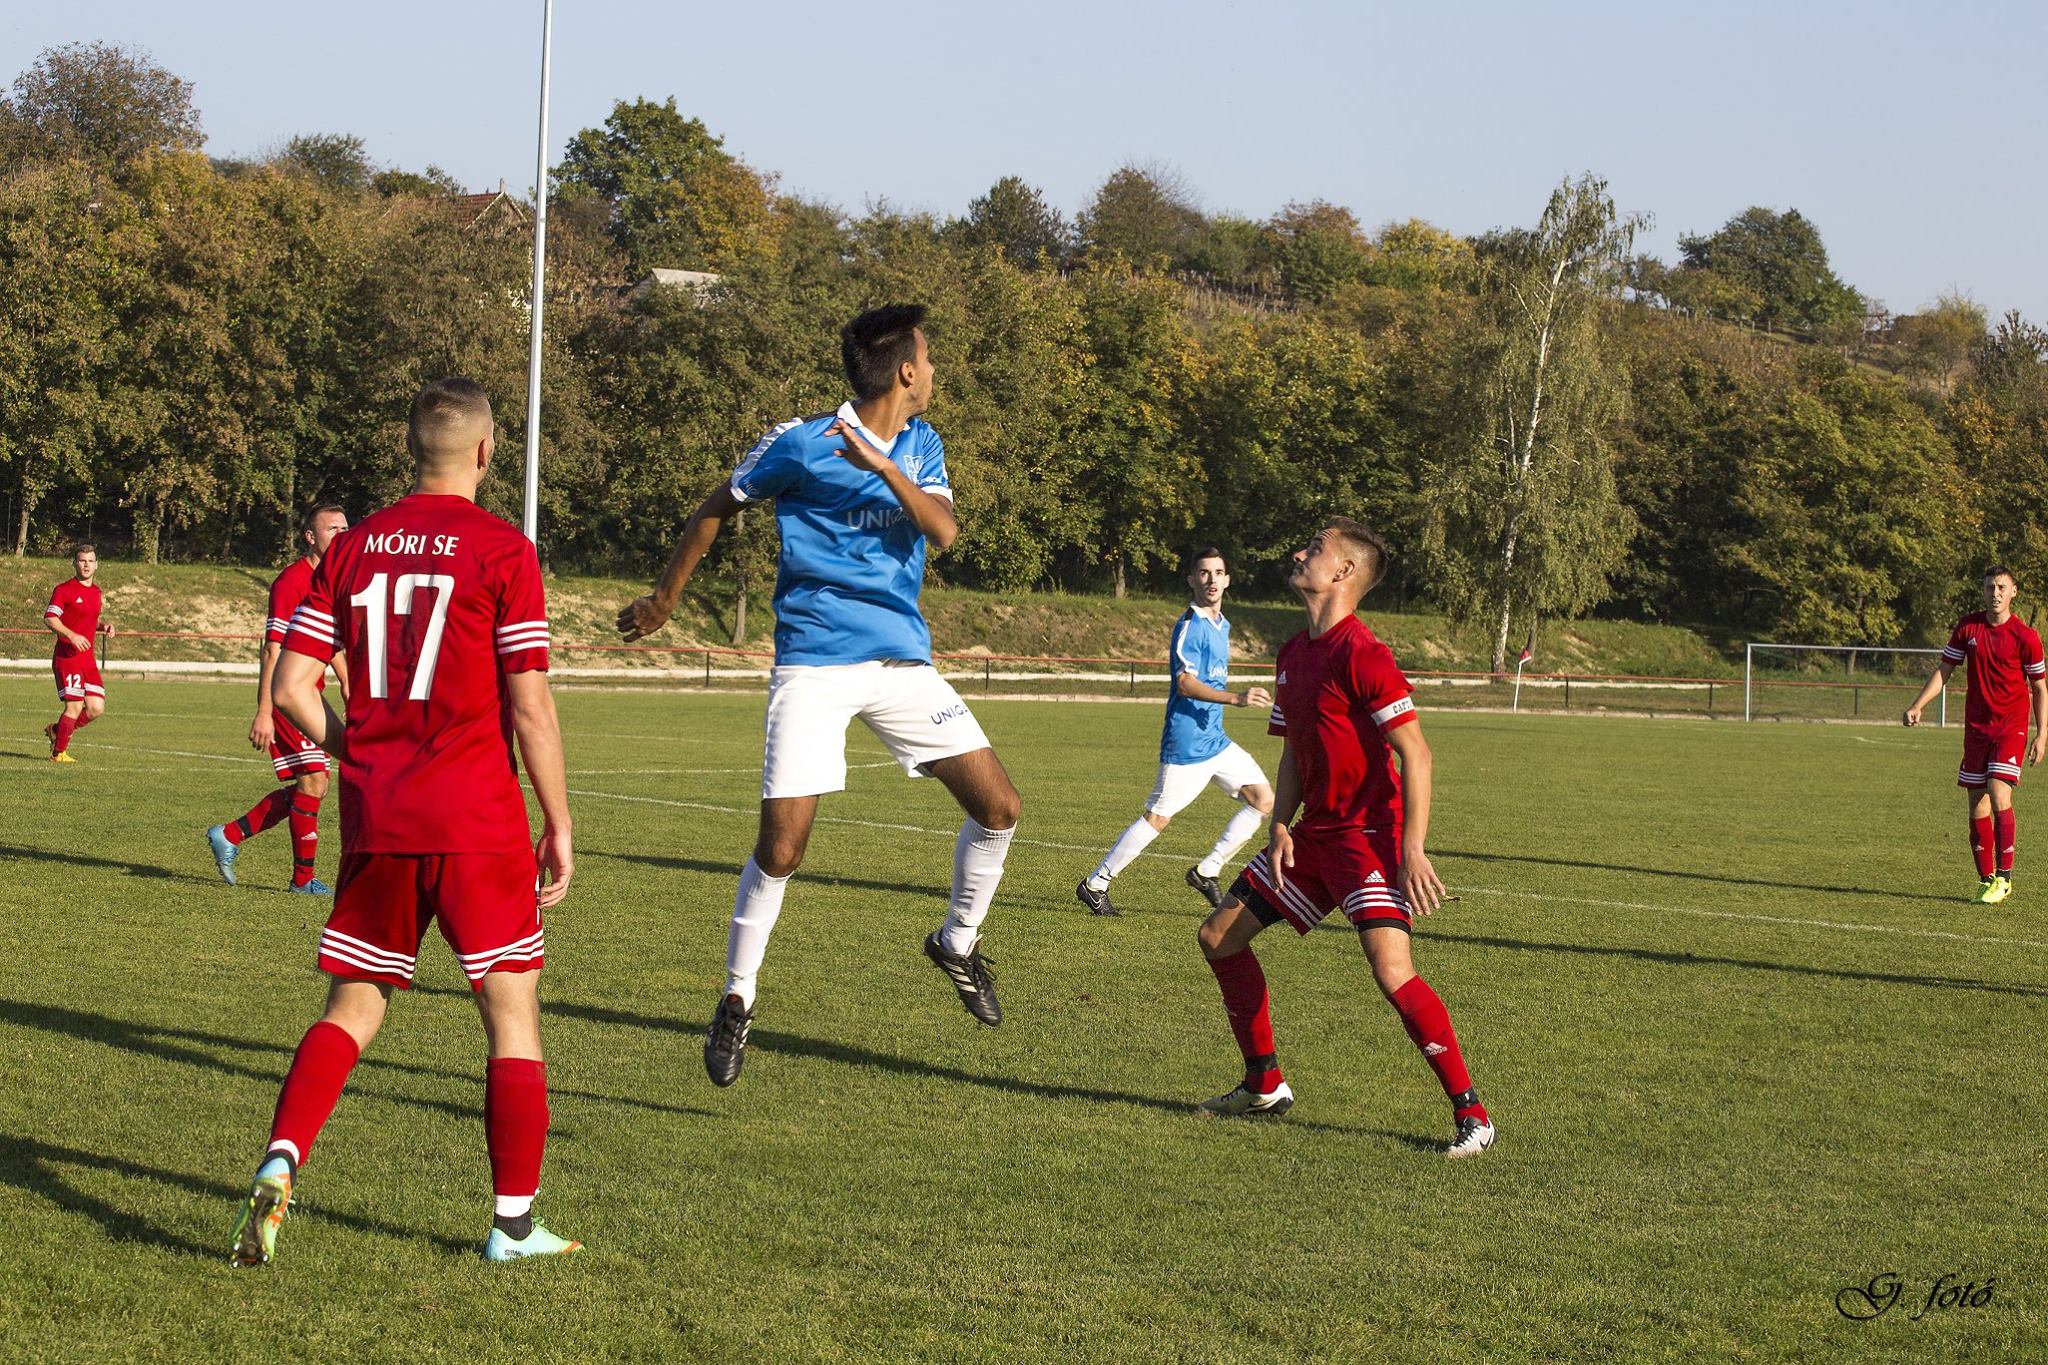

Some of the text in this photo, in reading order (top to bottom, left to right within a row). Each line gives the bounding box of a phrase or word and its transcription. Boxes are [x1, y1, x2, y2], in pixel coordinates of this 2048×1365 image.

[363, 528, 460, 556] MÓRI SE
[350, 572, 455, 700] 17
[66, 673, 82, 688] 12
